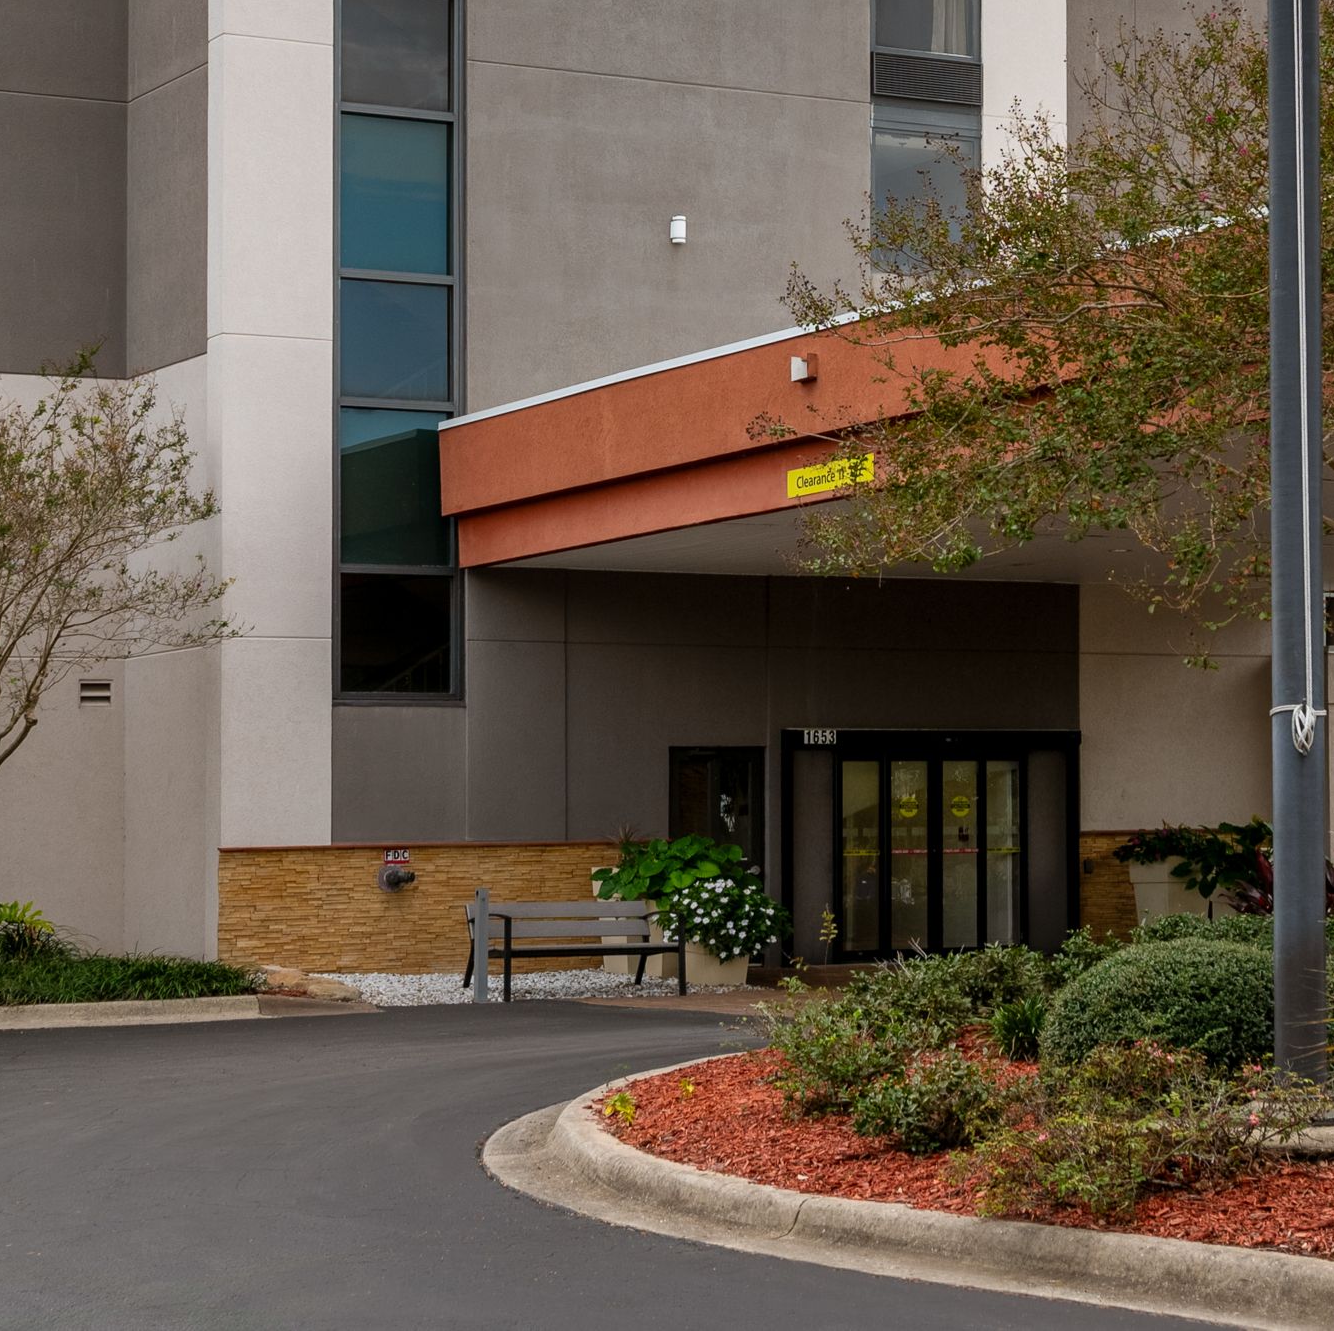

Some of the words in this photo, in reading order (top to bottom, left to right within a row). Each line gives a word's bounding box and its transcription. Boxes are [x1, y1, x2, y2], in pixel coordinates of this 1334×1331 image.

[796, 472, 836, 489] Clearance
[806, 730, 834, 744] 1653
[385, 850, 408, 860] FDC
